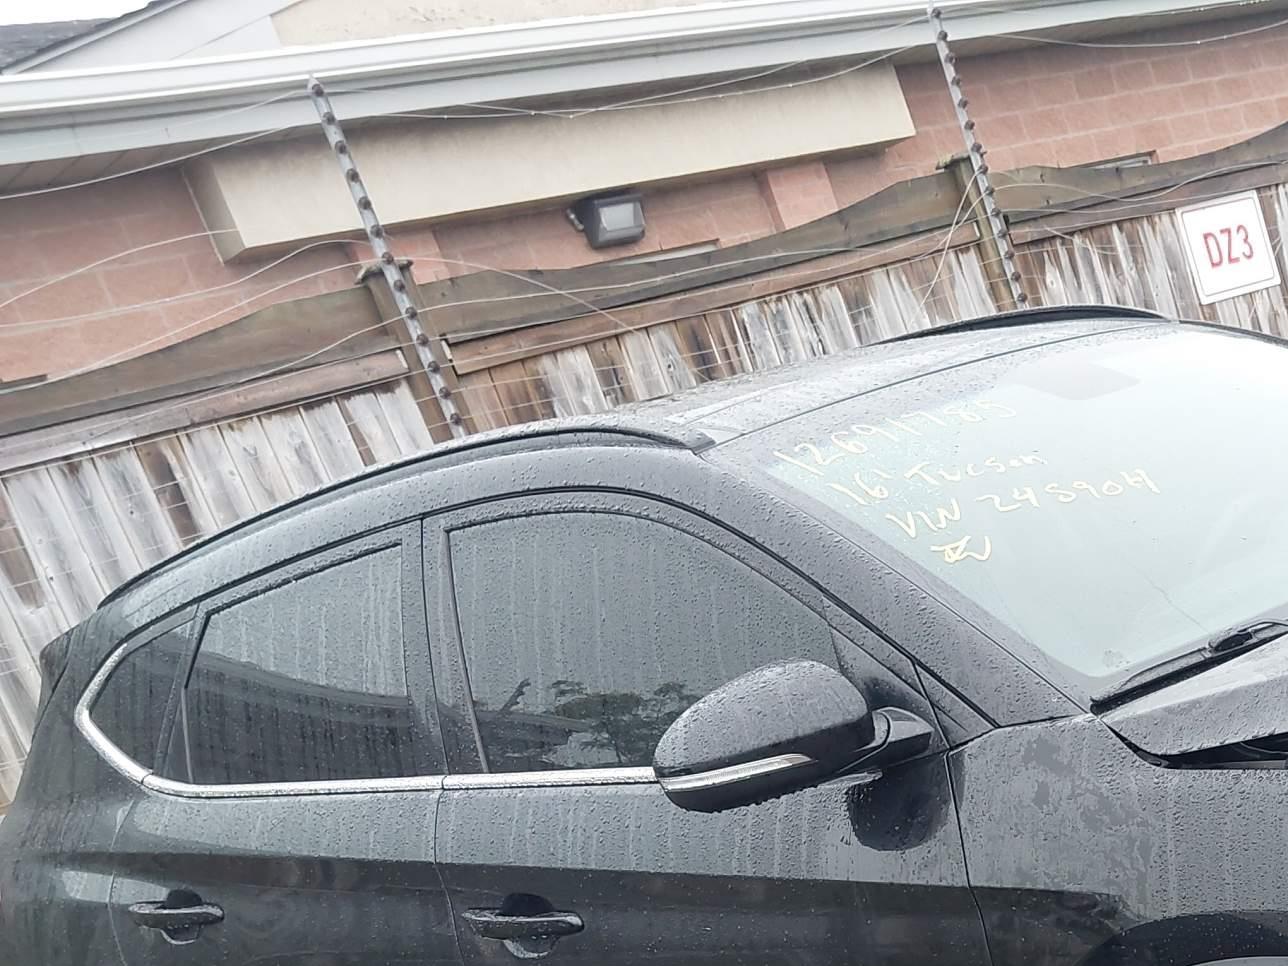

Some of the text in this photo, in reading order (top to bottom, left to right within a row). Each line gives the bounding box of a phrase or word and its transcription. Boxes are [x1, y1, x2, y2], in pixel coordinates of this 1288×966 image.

[1202, 224, 1254, 269] DZ3
[773, 399, 1017, 476] 12691785
[885, 498, 962, 539] VIN
